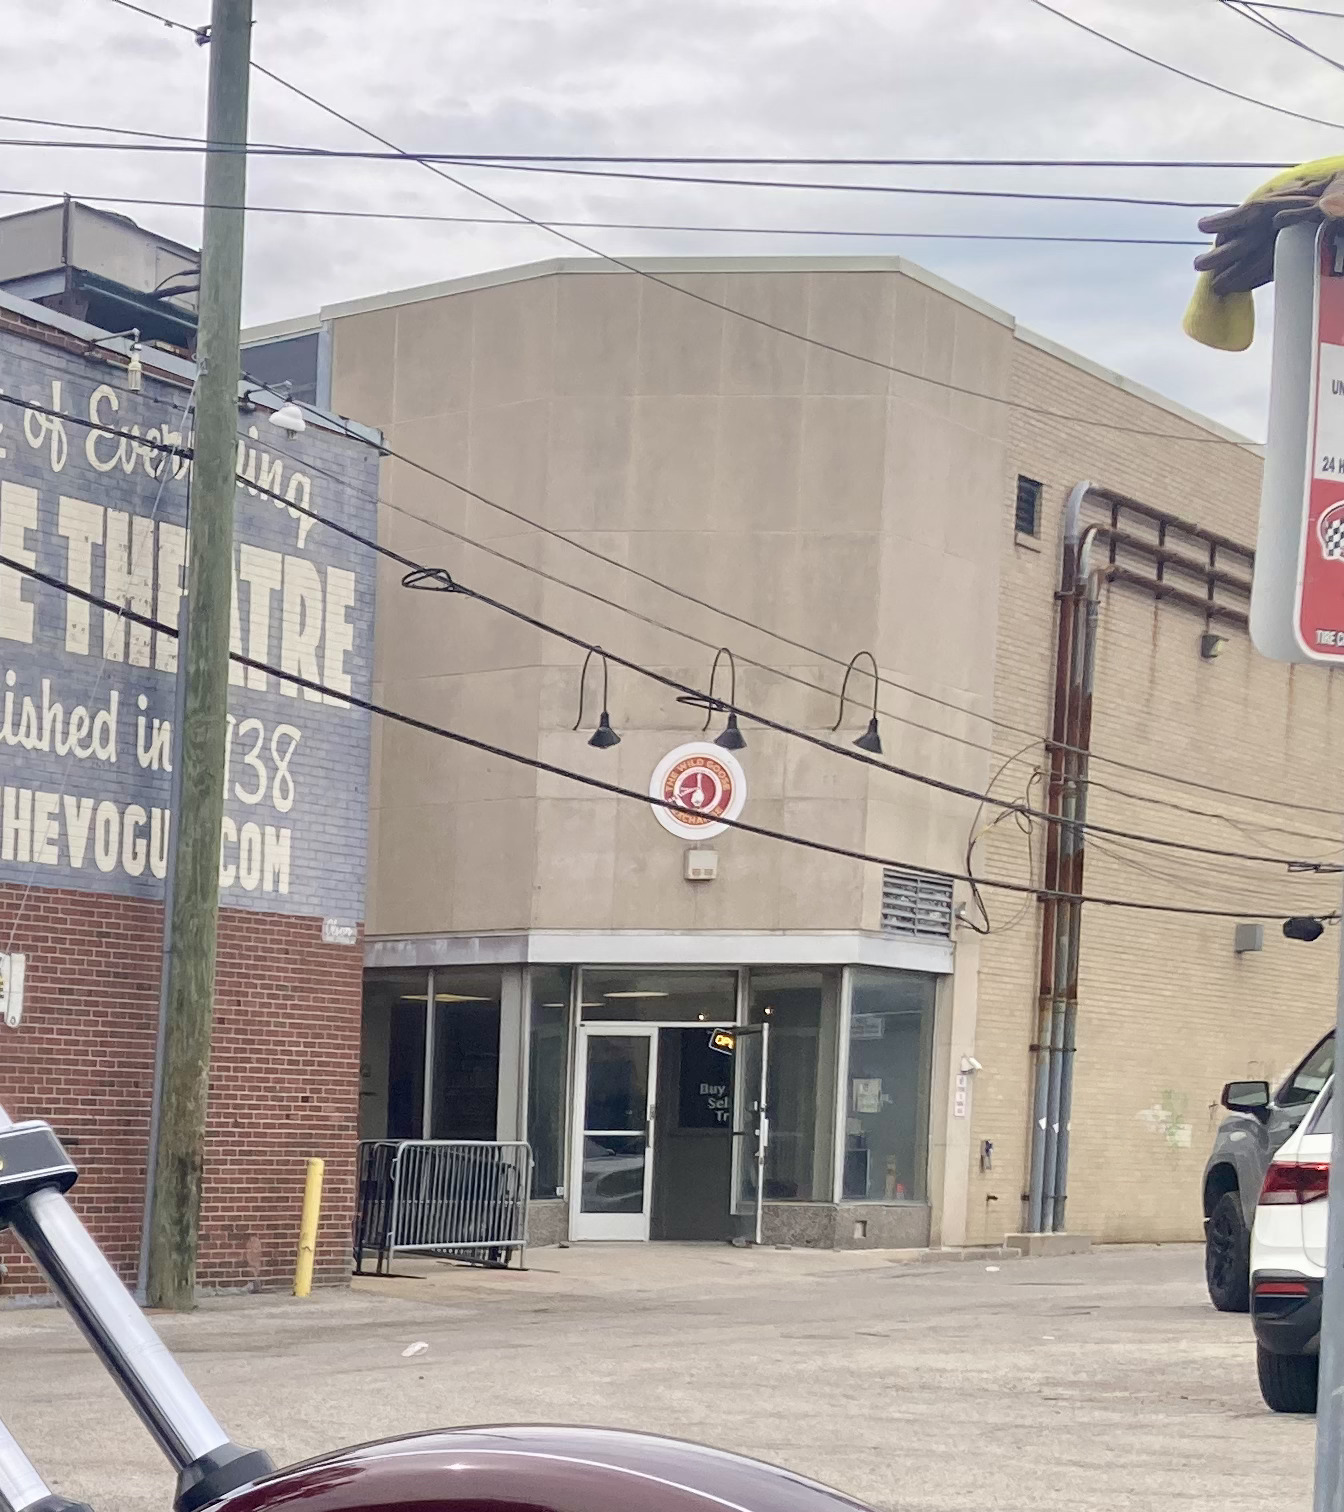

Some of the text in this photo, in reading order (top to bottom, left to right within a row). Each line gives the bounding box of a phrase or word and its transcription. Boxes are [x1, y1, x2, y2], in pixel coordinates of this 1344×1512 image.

[23, 380, 69, 473] of
[85, 384, 317, 549] Evering
[1322, 455, 1335, 473] 24
[136, 693, 173, 772] in
[223, 713, 302, 813] 38
[700, 1083, 726, 1096] Buy
[707, 1096, 728, 1110] Sel
